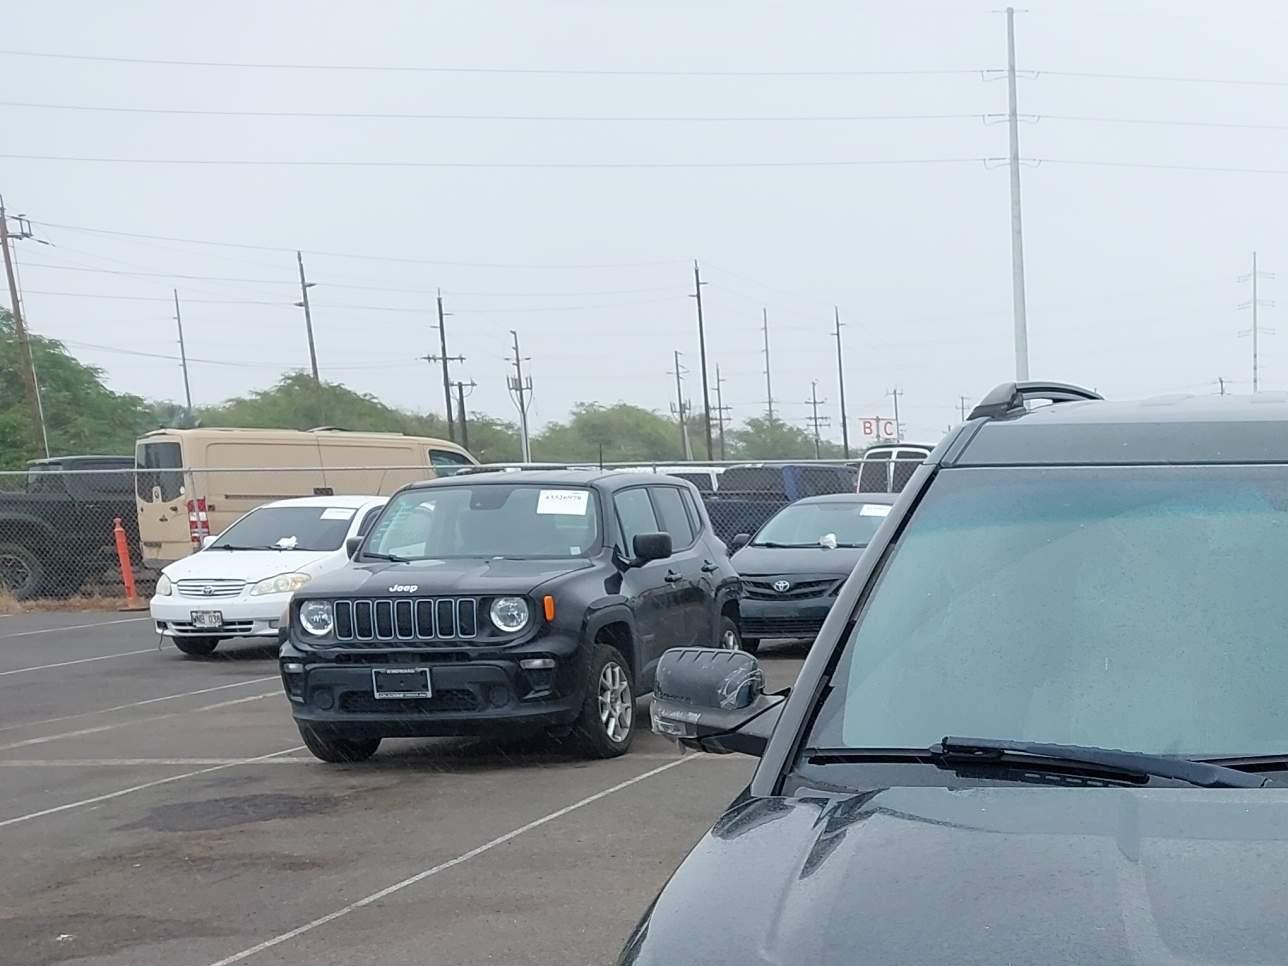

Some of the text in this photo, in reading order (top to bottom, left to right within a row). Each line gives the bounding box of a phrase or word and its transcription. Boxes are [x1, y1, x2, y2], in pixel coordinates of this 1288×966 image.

[863, 421, 873, 435] B
[884, 421, 894, 436] C
[389, 584, 418, 593] Jeep
